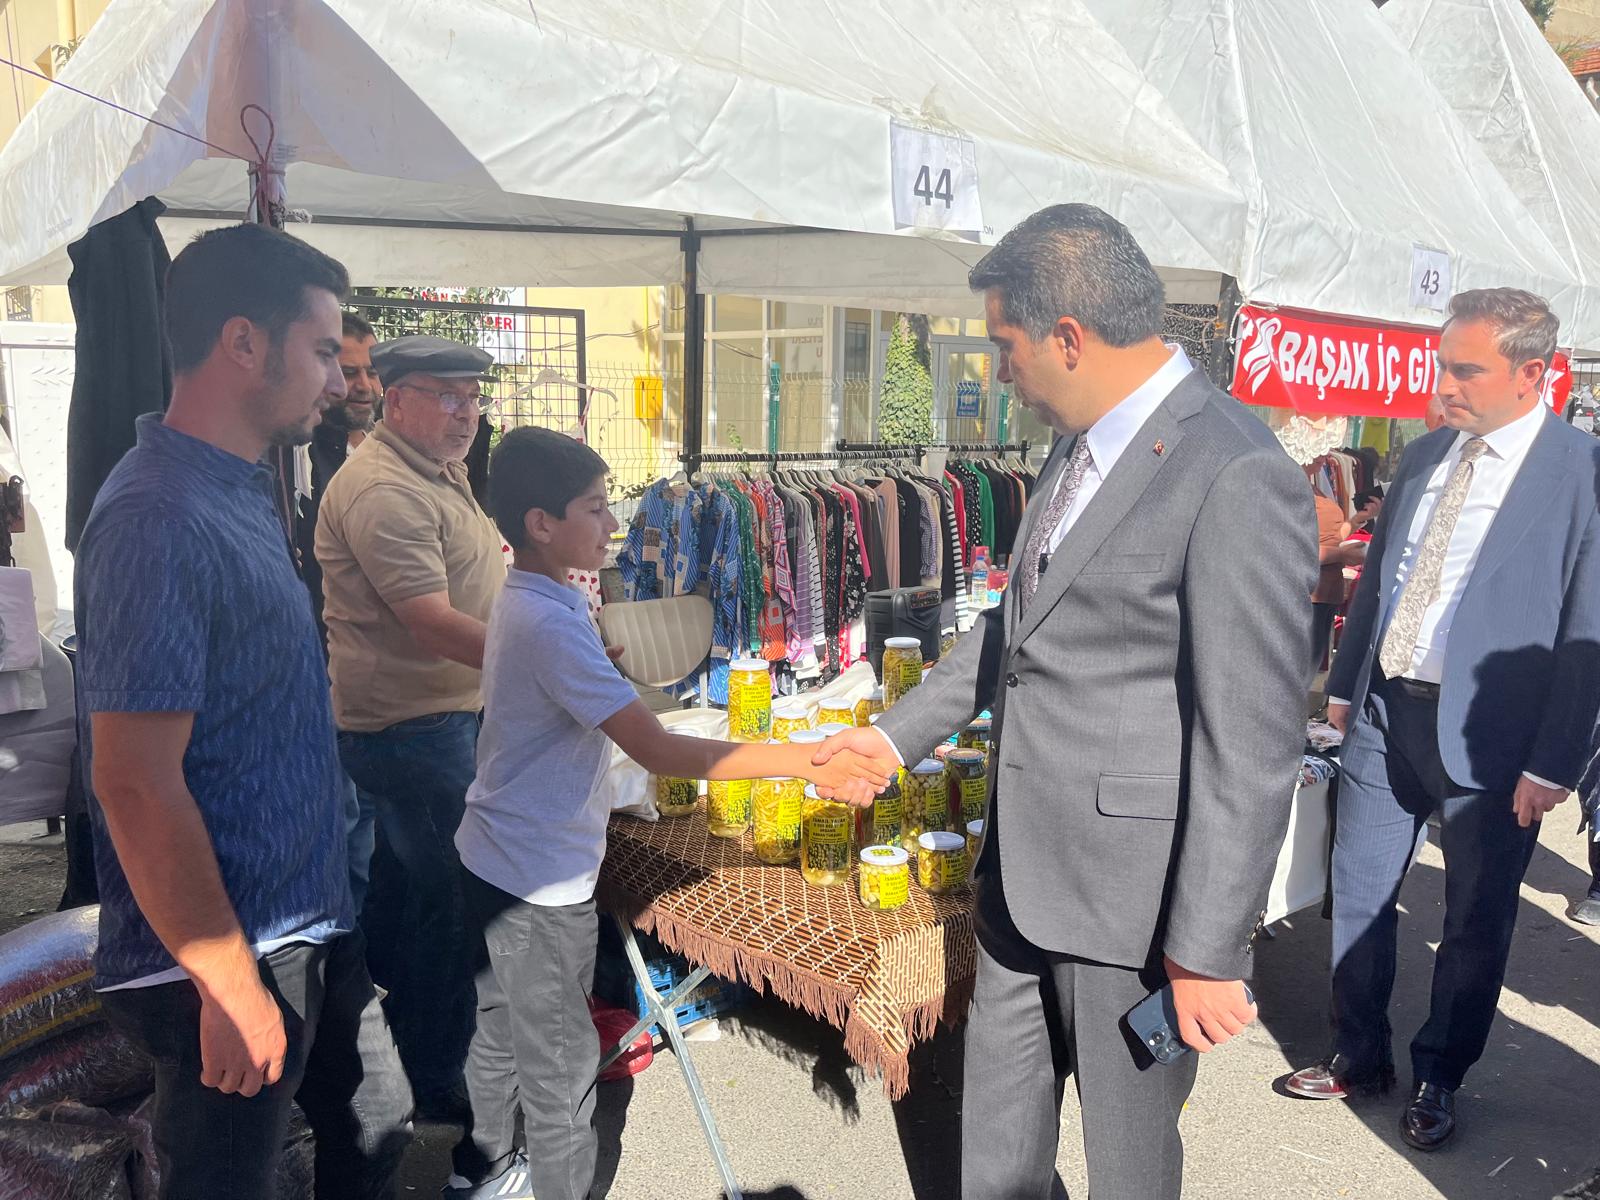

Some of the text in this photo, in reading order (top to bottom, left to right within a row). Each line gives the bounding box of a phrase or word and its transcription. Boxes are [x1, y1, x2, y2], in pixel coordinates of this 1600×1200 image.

[913, 165, 954, 209] 44
[1420, 269, 1440, 295] 43
[1278, 330, 1370, 400] BAŞAK
[1376, 332, 1402, 405] İÇ
[1408, 337, 1439, 394] GİY
